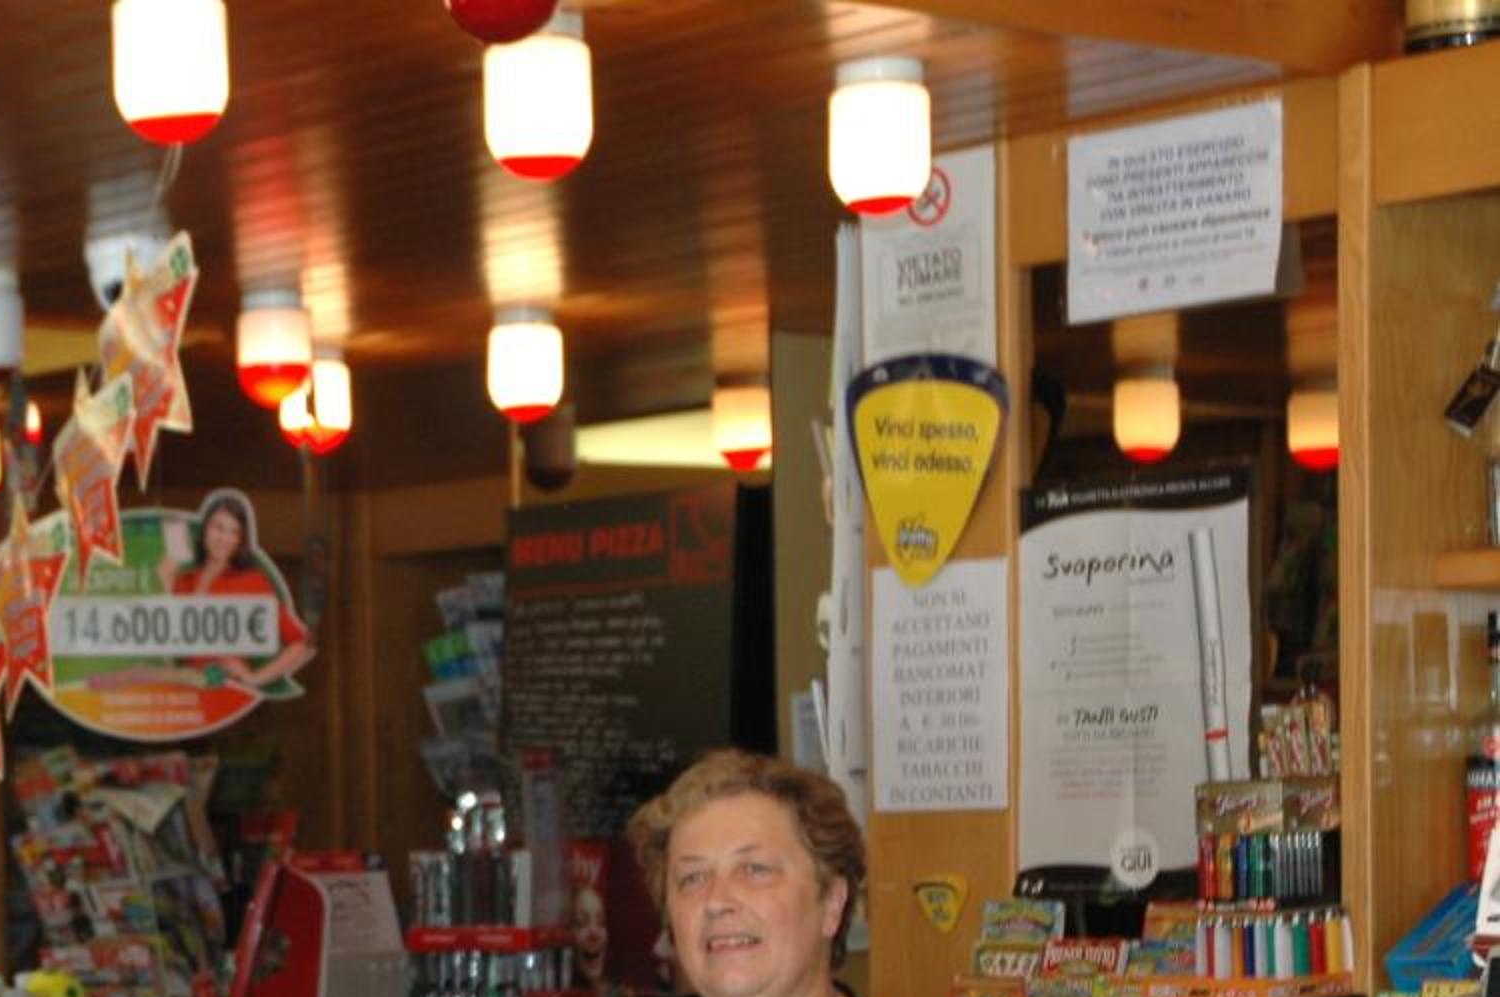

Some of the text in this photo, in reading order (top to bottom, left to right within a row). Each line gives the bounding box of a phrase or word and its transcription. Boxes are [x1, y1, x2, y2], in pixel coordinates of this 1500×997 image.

[874, 416, 980, 444] Vinci spesso,
[872, 449, 909, 471] vinci
[588, 523, 664, 559] PIZZA
[1041, 549, 1174, 587] Svaporina
[65, 605, 240, 645] 14.600.000
[246, 604, 269, 644] €
[892, 611, 991, 634] ACCETTANO
[892, 637, 989, 659] PAGAMENTI
[893, 661, 986, 684] BANCOMAT
[899, 686, 980, 707] INFERIORI
